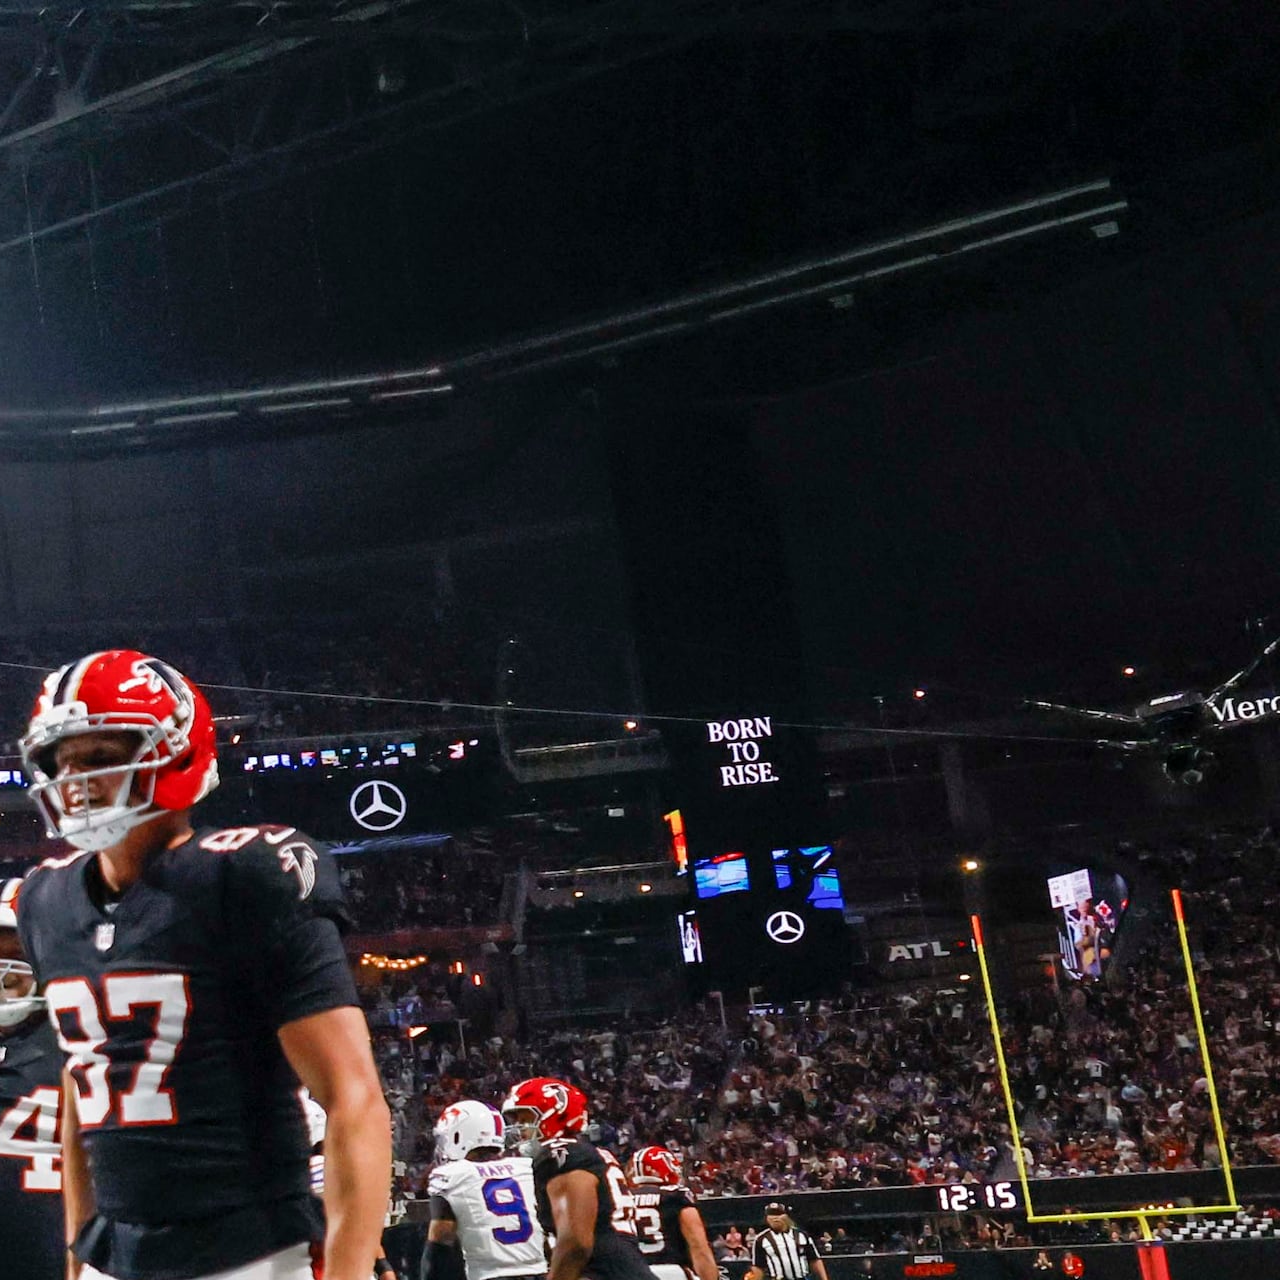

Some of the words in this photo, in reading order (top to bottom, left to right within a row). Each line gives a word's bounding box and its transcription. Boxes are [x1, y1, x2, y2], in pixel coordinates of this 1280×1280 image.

[706, 716, 772, 743] BORN
[727, 740, 760, 763] TO
[720, 761, 780, 787] RISE.
[889, 941, 951, 962] ATL
[43, 971, 191, 1128] 87
[476, 1163, 515, 1178] RAPP
[939, 1181, 1017, 1212] 12:15
[481, 1177, 534, 1246] 9
